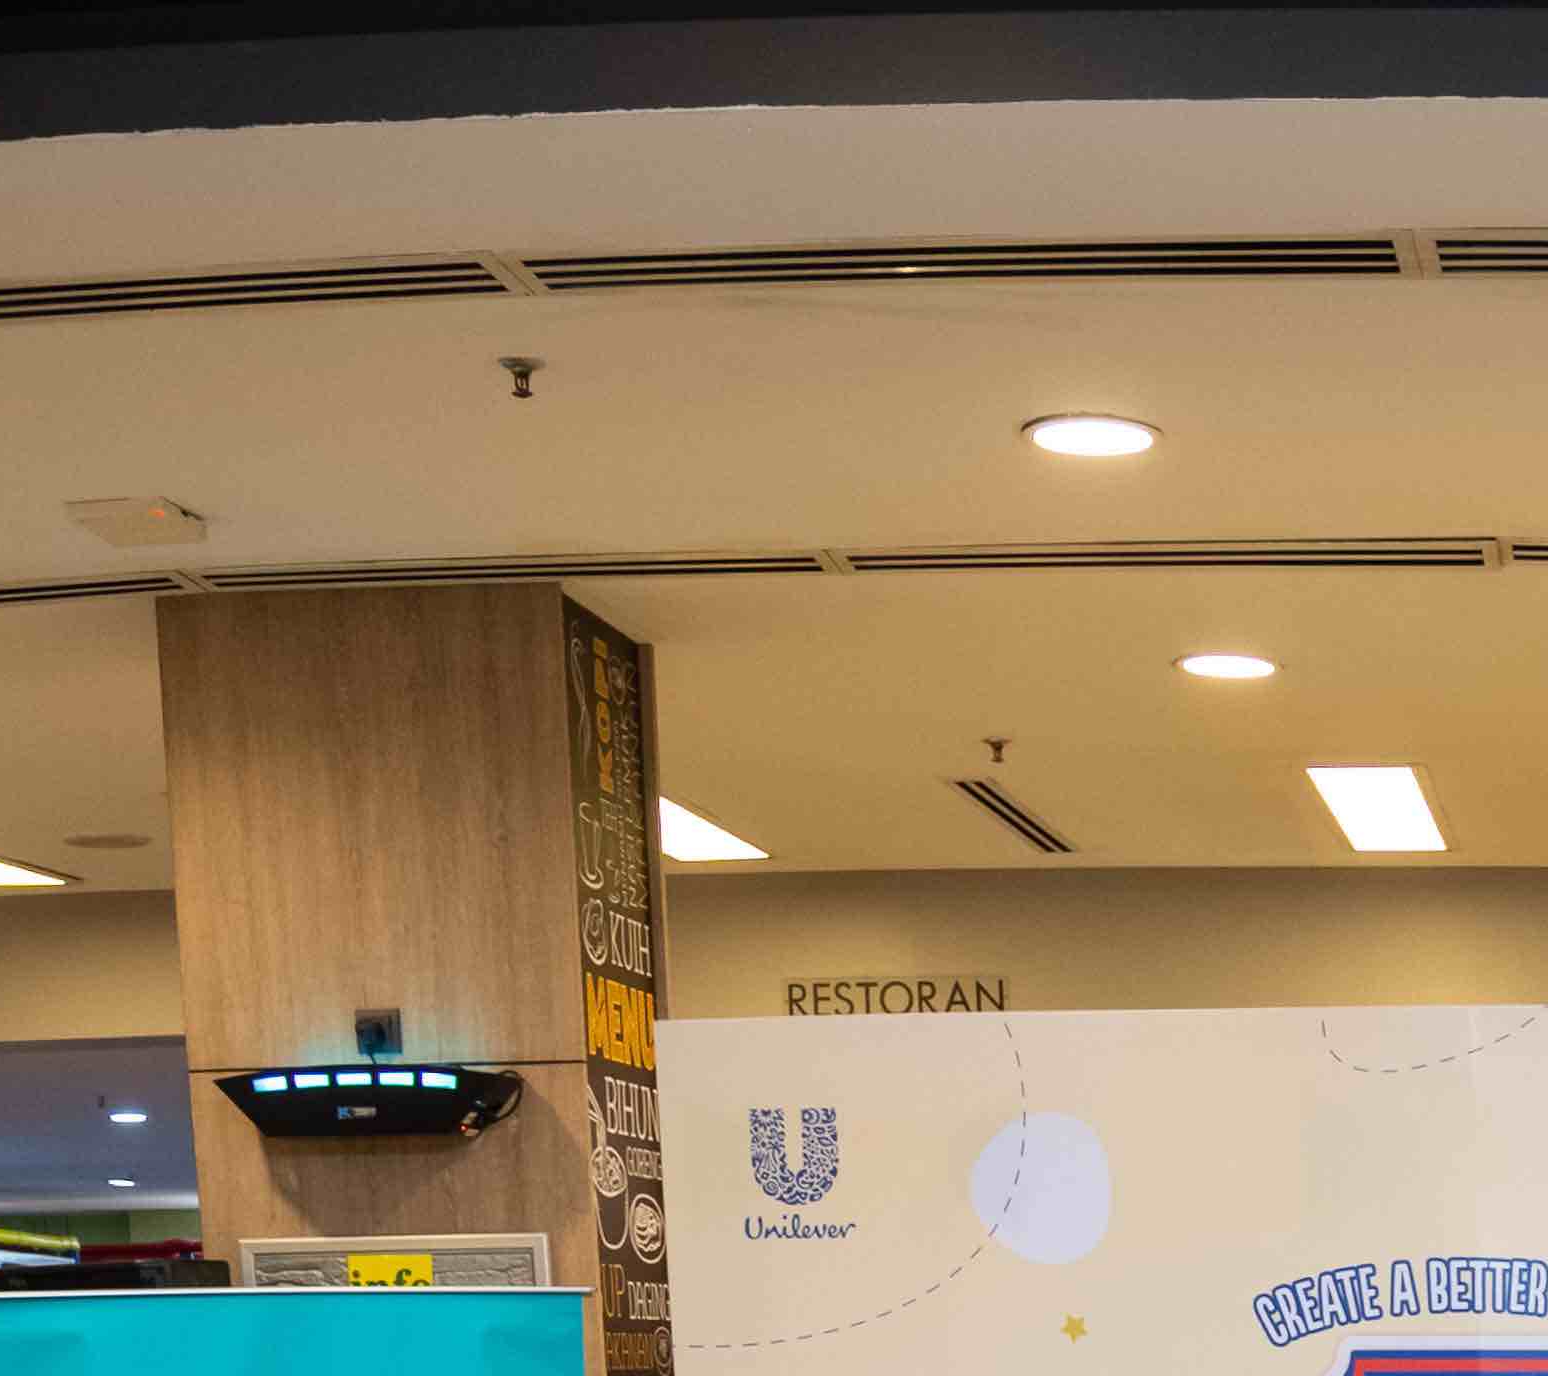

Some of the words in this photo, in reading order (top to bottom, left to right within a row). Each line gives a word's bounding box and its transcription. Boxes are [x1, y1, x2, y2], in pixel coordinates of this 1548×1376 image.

[609, 911, 652, 976] KUIH
[585, 971, 655, 1071] MENU
[786, 979, 1006, 1016] RESTORAN
[604, 1076, 660, 1141] BIHUN
[744, 1214, 856, 1240] Unilever
[601, 1263, 625, 1318] UP
[1253, 1263, 1382, 1347] CREATE
[1391, 1260, 1419, 1317] A
[1426, 1257, 1548, 1317] BETTER
